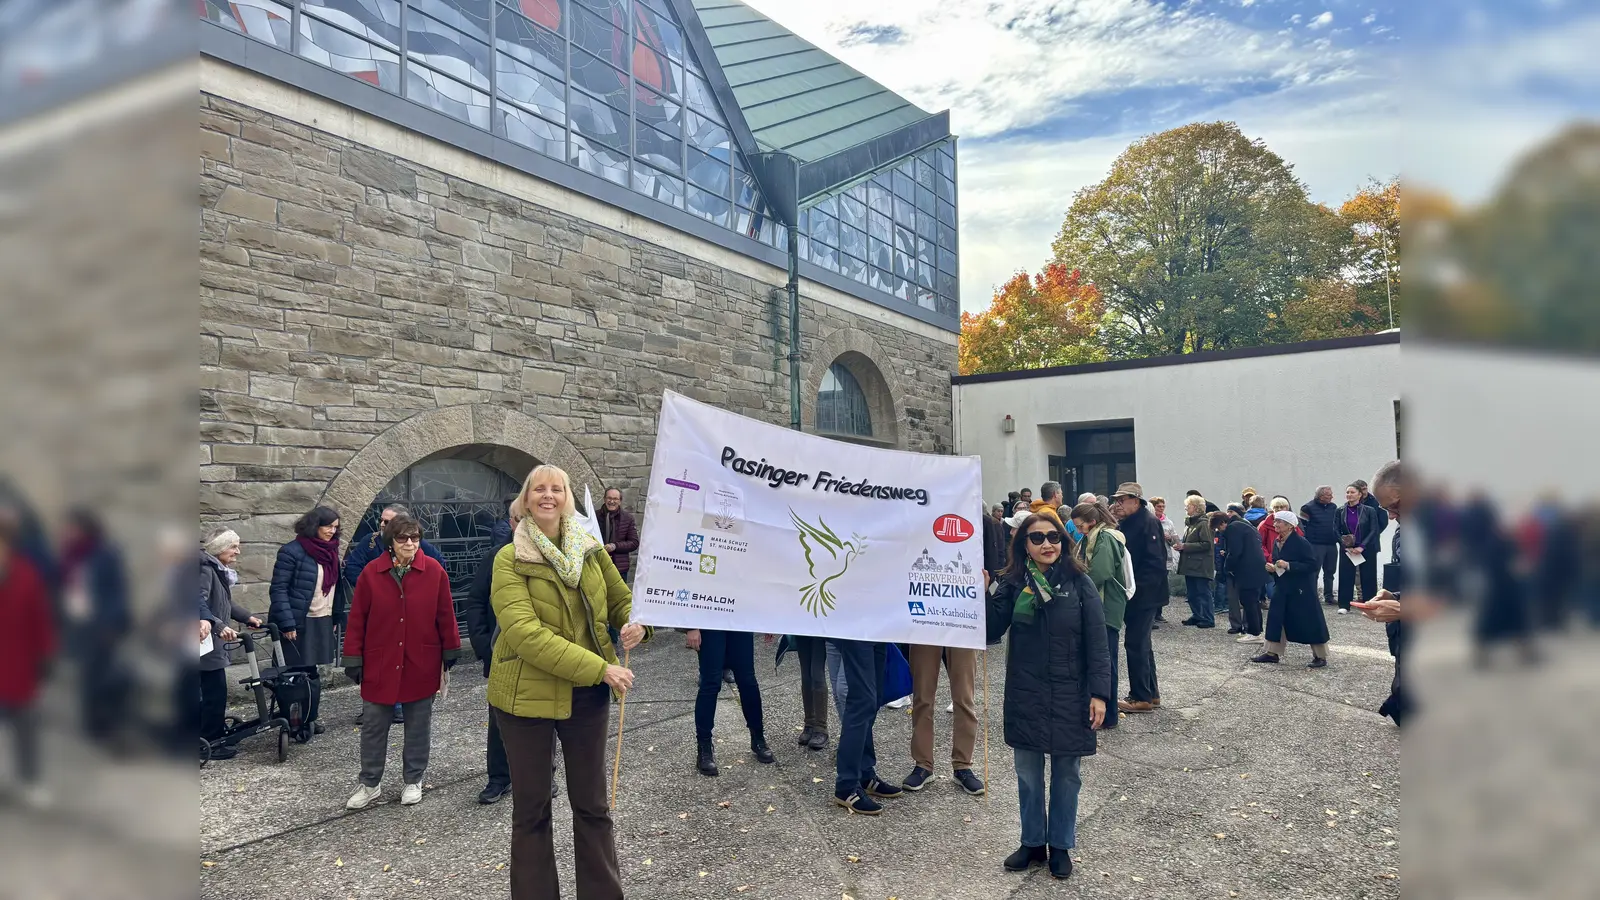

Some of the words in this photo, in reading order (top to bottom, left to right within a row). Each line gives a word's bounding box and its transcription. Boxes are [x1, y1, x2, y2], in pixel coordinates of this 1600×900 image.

[720, 446, 808, 488] Pasinger
[812, 470, 929, 505] Friedensweg
[718, 544, 747, 553] HILDEGARD
[728, 538, 748, 547] SCHUTZ
[653, 555, 693, 566] PFARRVERBAND
[908, 572, 976, 585] PFARRVERBAND
[646, 587, 675, 597] BETH
[691, 593, 735, 605] SHALOM
[909, 581, 977, 599] MENZING
[927, 606, 978, 620] Alt-Katholisch
